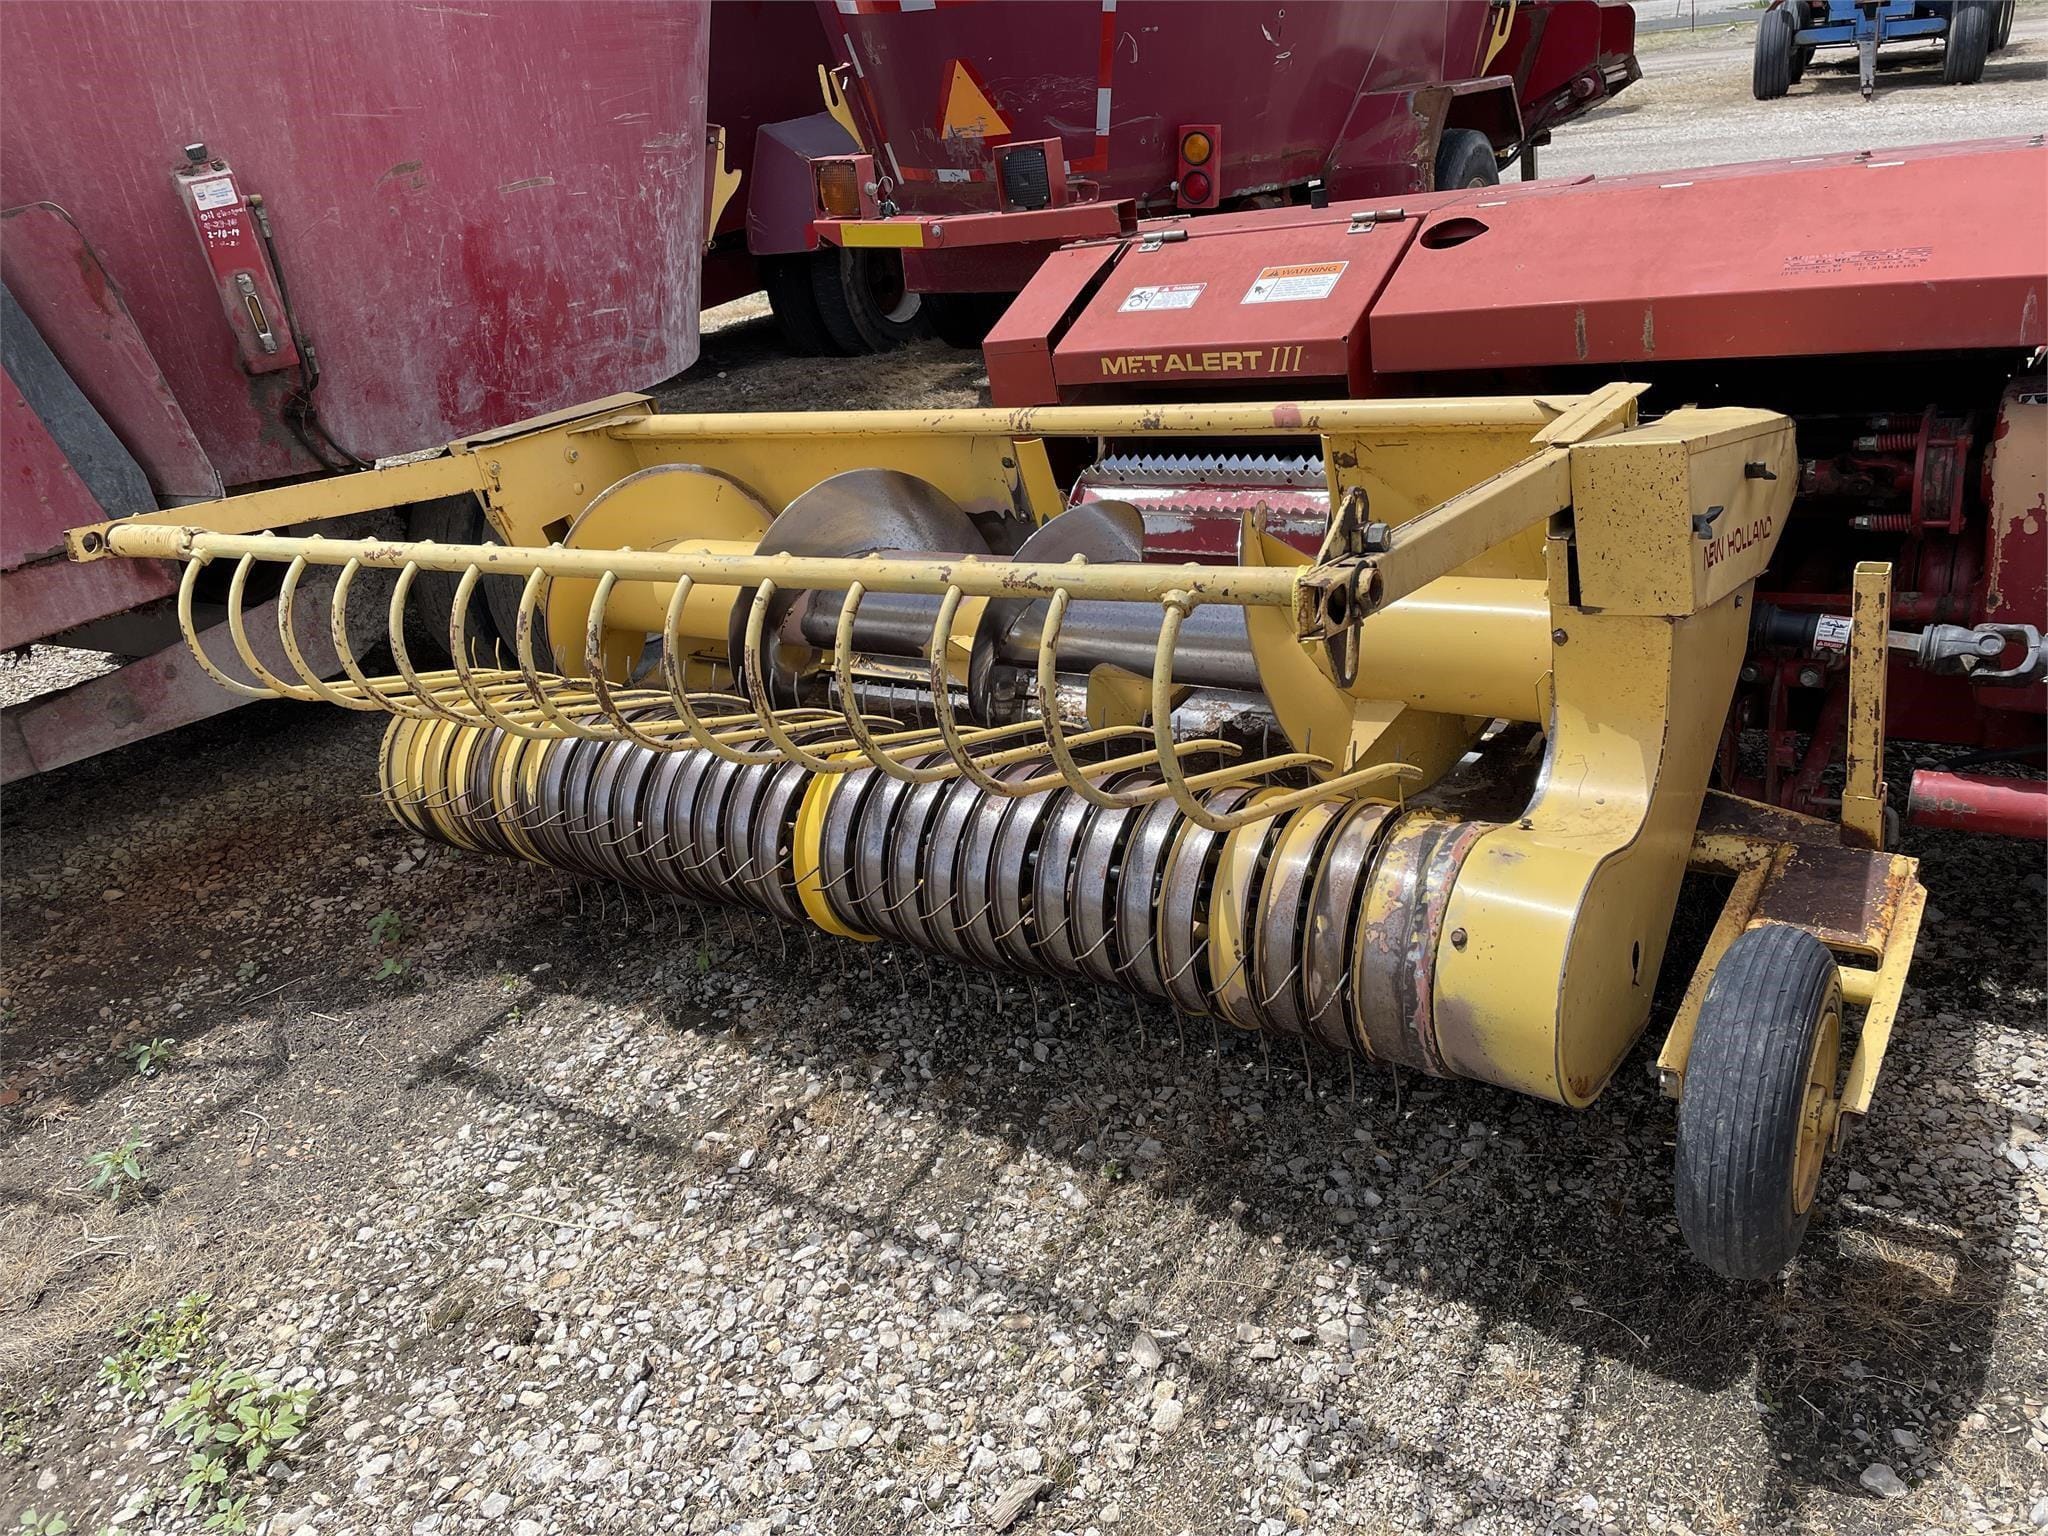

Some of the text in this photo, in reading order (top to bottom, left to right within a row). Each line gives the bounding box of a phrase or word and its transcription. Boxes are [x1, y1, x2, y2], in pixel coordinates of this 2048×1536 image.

[200, 210, 215, 221] Oil
[1282, 265, 1337, 275] WARNING
[1100, 351, 1263, 376] METALERT
[1703, 515, 1773, 572] NEW HOLLAND
